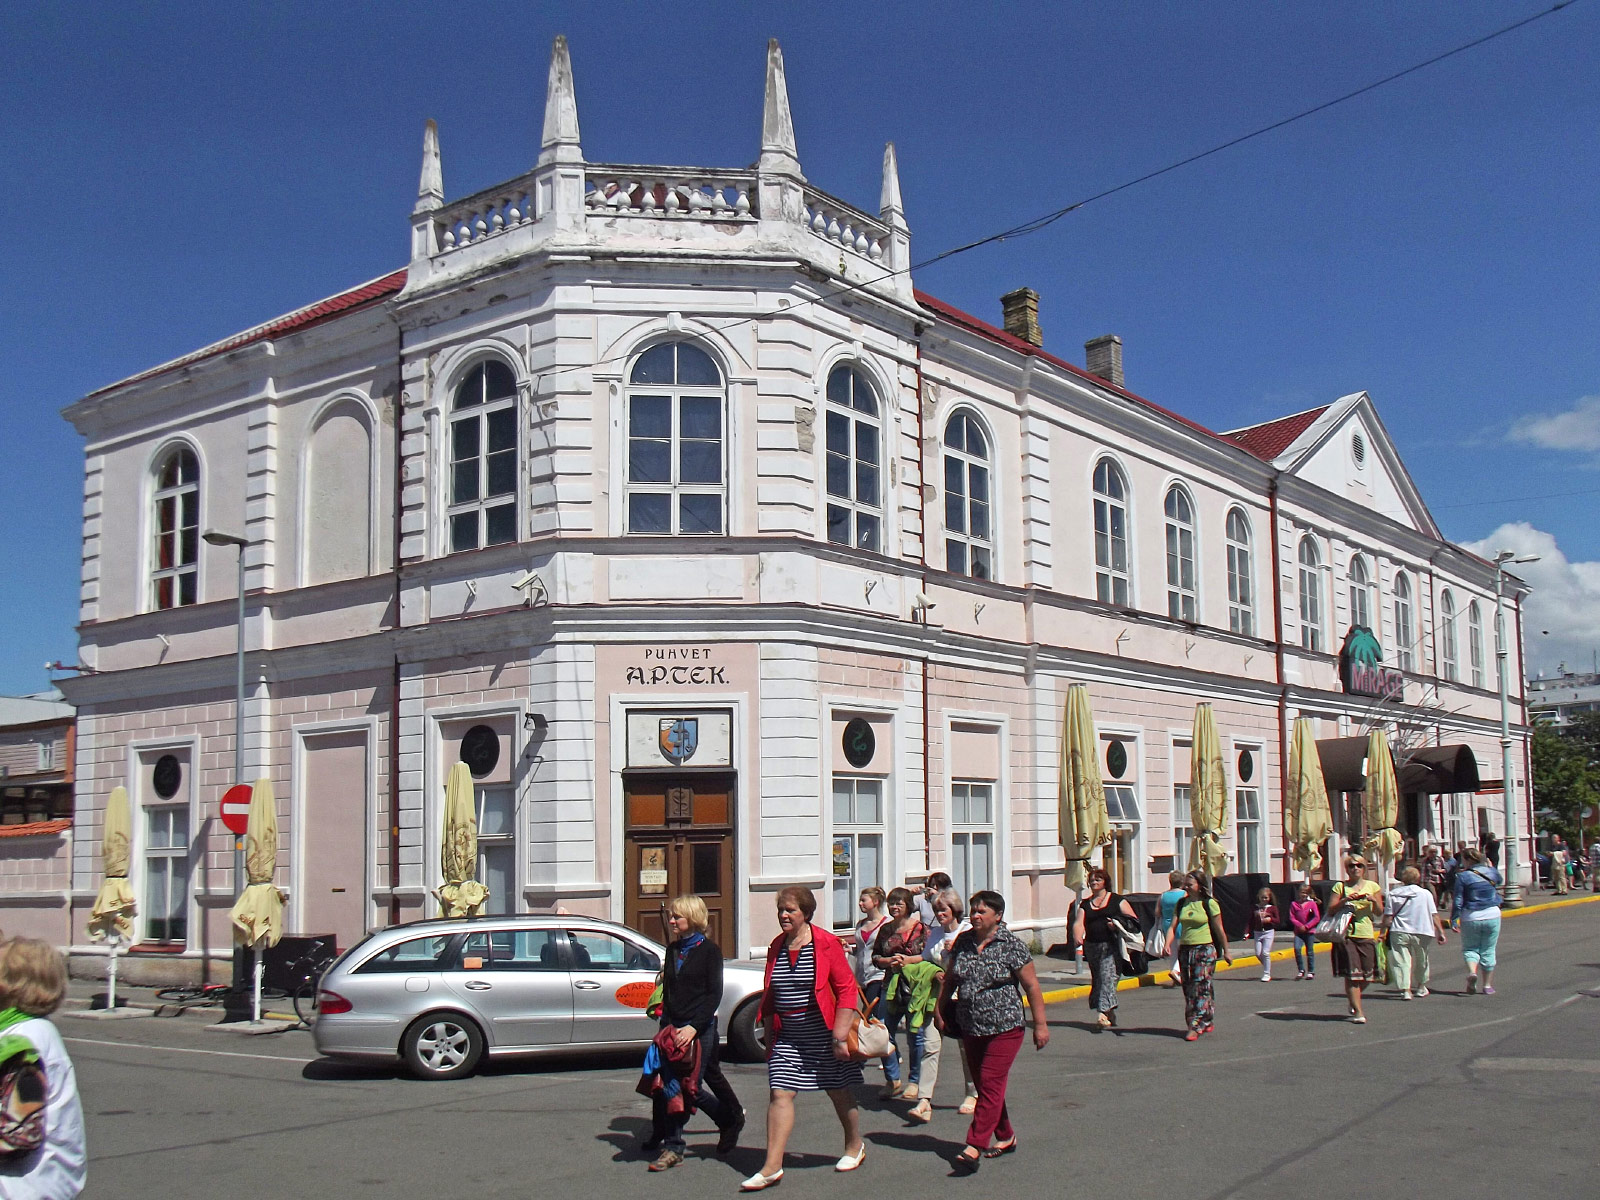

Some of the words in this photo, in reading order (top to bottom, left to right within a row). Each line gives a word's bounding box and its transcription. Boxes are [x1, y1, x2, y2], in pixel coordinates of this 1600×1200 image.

[645, 648, 712, 660] PUHVET
[626, 665, 730, 686] A.P.T.E.K.
[1352, 663, 1402, 698] MIRAGE
